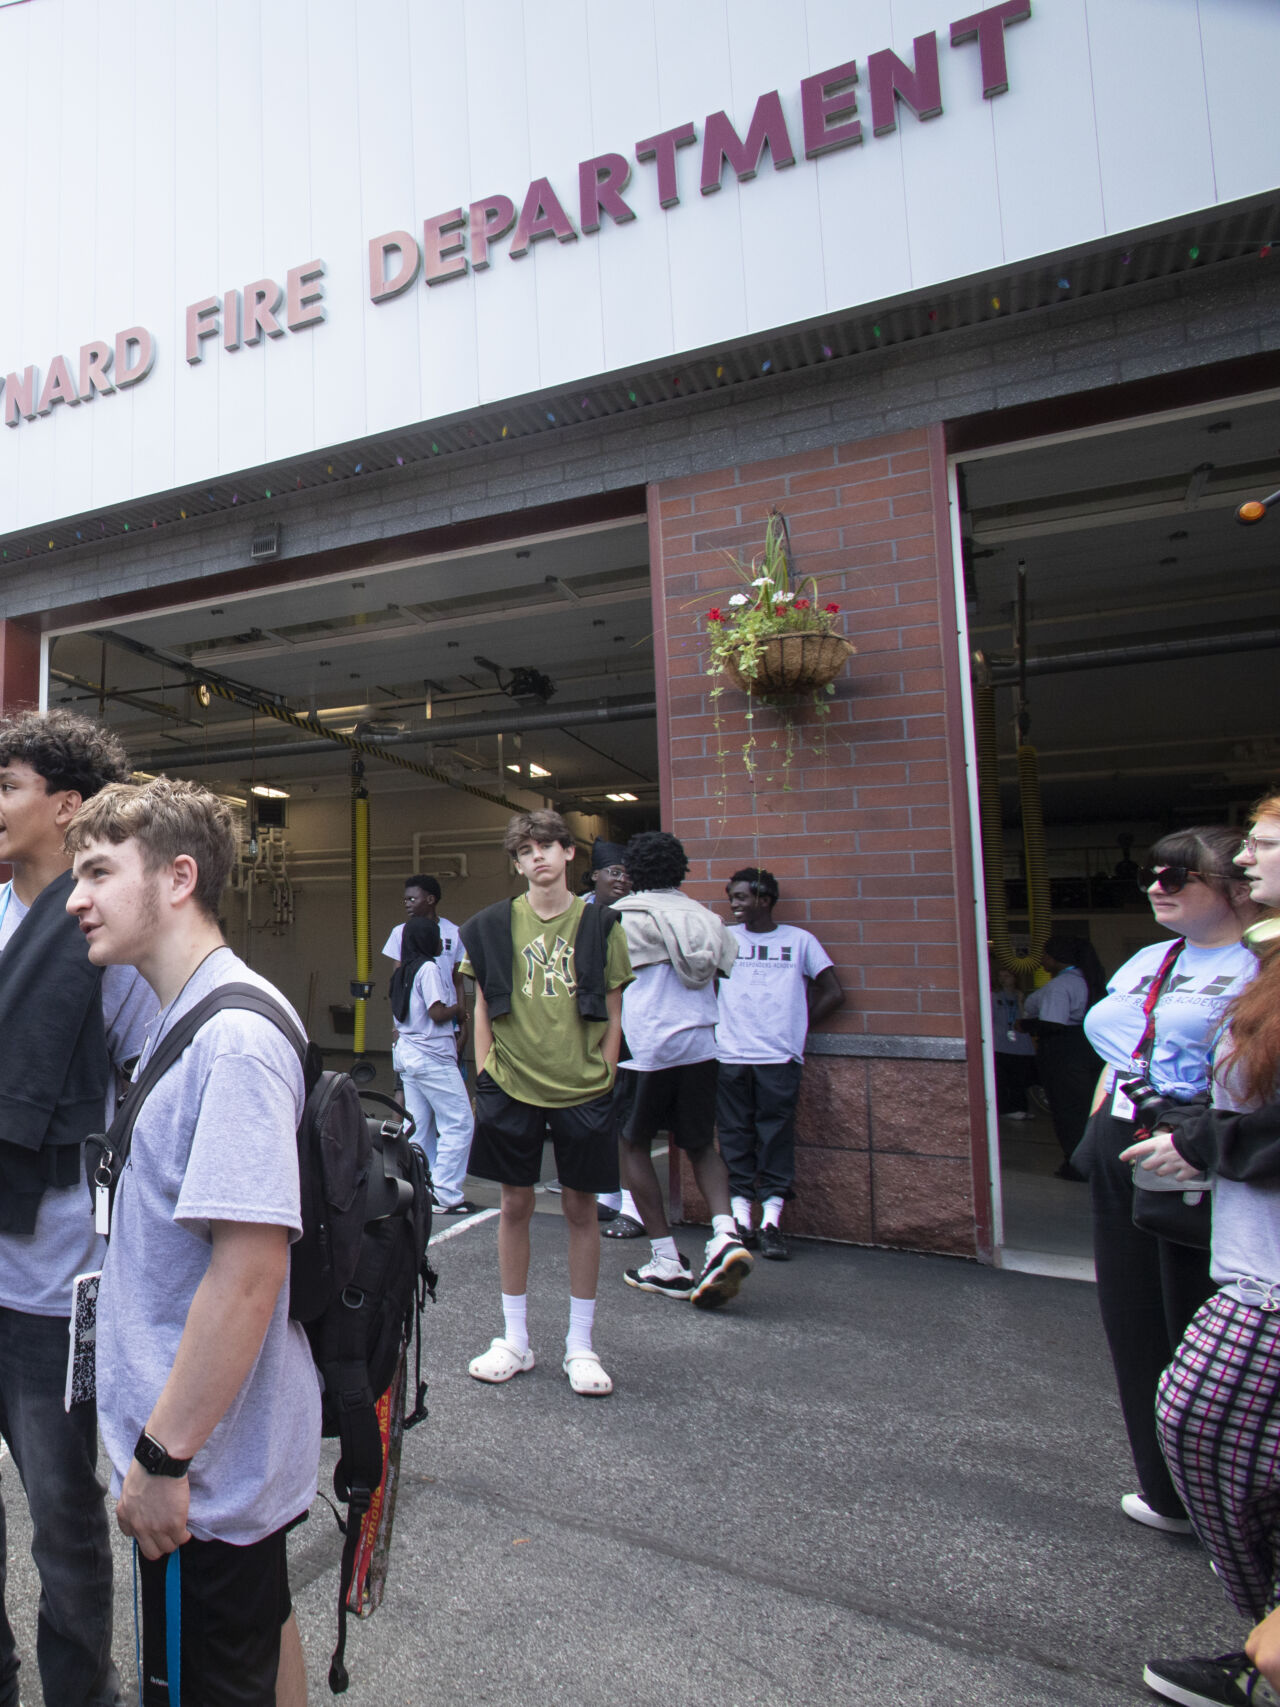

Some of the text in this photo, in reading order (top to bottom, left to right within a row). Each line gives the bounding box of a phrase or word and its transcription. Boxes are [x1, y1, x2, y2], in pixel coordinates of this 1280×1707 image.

[184, 259, 326, 366] FIRE
[368, 0, 1032, 305] DEPARTMENT
[521, 933, 577, 998] NY
[1175, 996, 1230, 1010] ACADEMY
